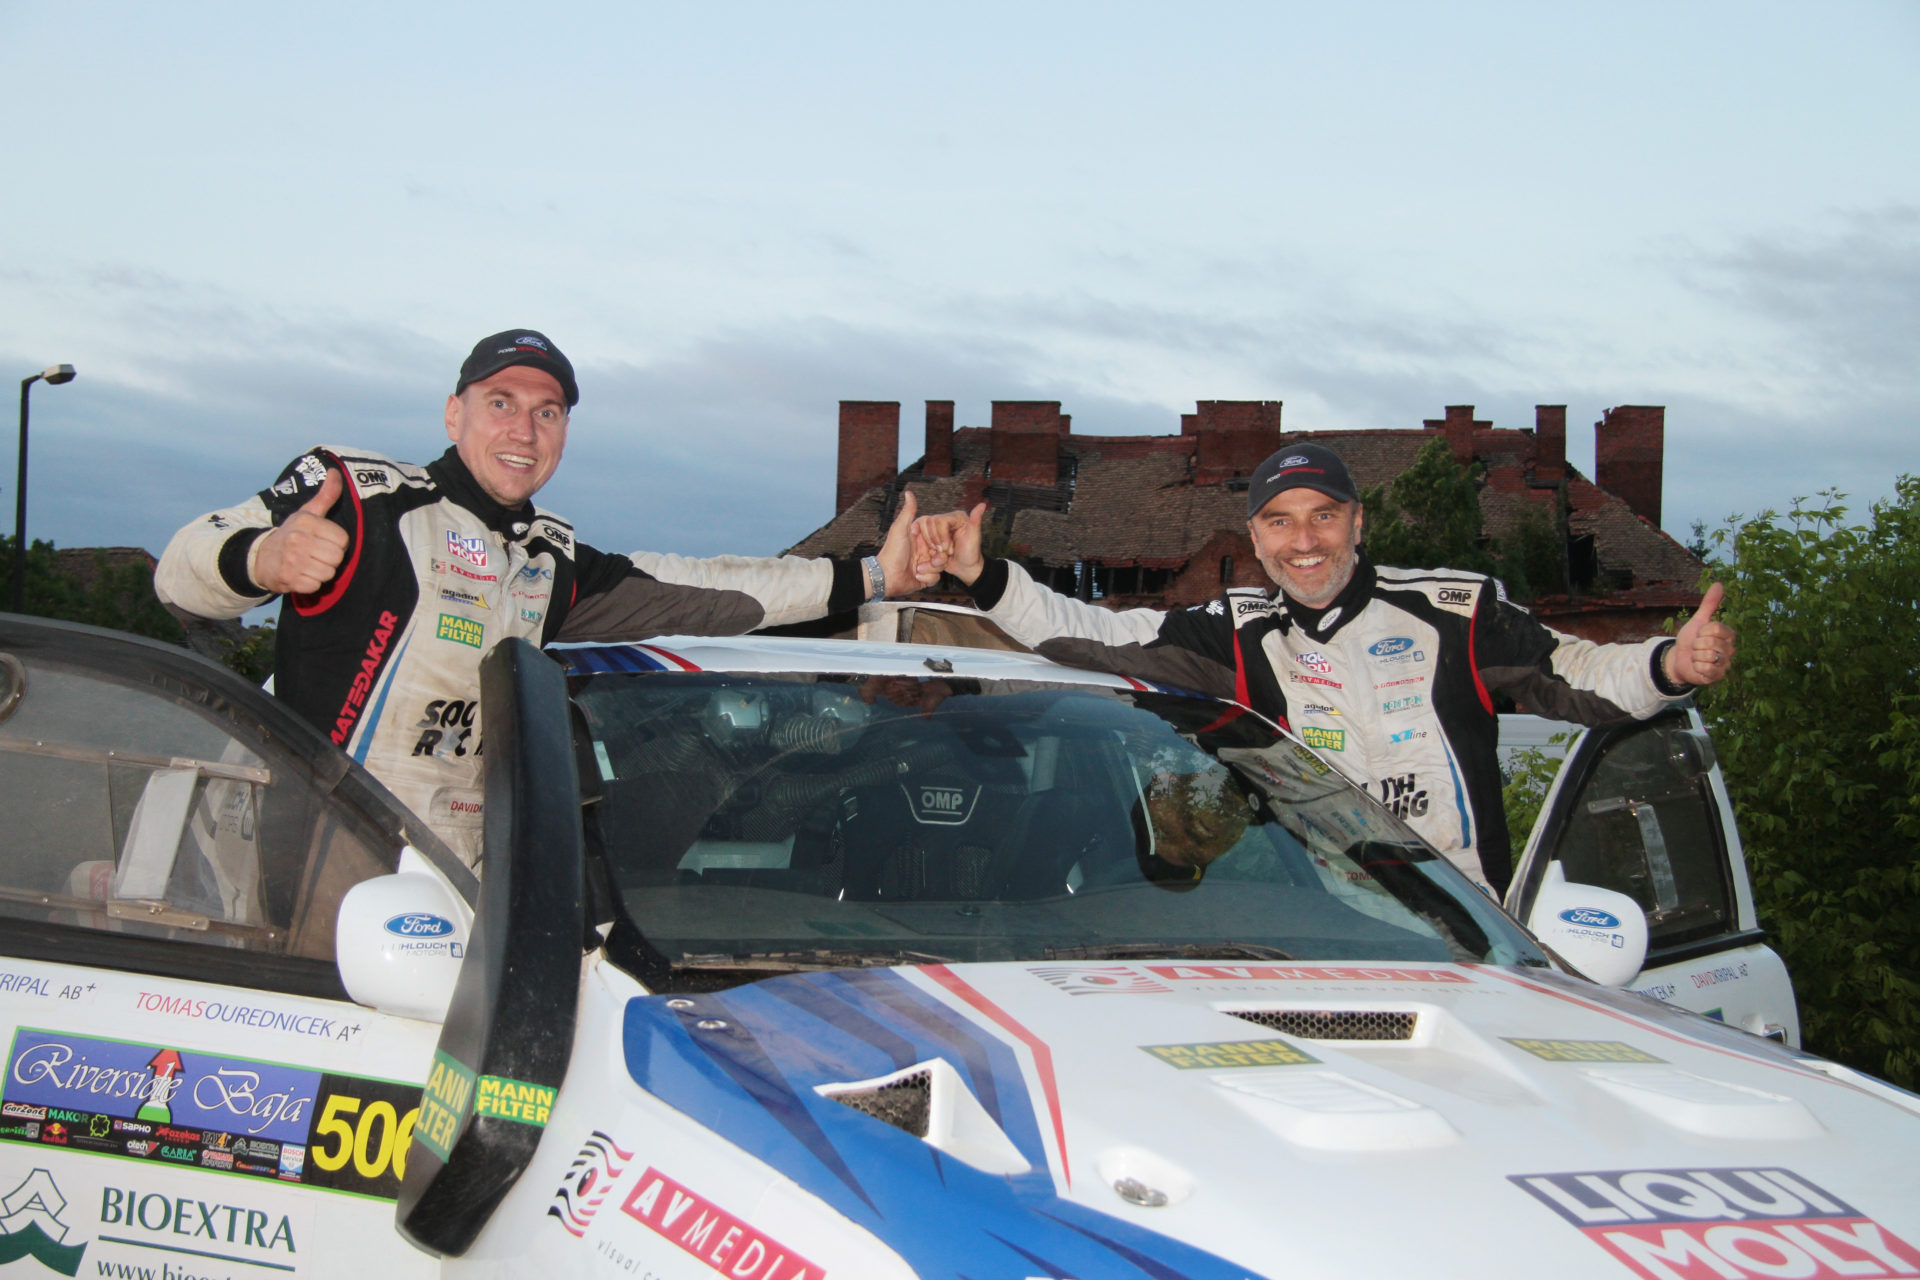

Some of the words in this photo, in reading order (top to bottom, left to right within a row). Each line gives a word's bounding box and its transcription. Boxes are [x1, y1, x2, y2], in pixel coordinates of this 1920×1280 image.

[356, 470, 390, 485] OMP
[544, 526, 571, 546] OMP
[449, 544, 485, 566] MOLY
[442, 588, 480, 602] agados
[1437, 589, 1472, 603] OMP
[441, 615, 482, 634] MANN
[439, 627, 481, 647] FILTER
[1375, 640, 1406, 655] Ford
[1303, 728, 1342, 741] MANN
[1304, 738, 1342, 750] FILTER
[450, 801, 483, 813] DAVID
[922, 791, 963, 809] OMP
[401, 914, 442, 933] Ford
[1570, 910, 1609, 925] Ford
[1568, 928, 1610, 939] HLOUCH
[400, 942, 448, 950] HLOUCH
[1152, 1041, 1278, 1057] MANN
[1172, 1052, 1309, 1067] FILTER
[14, 1043, 184, 1104] Riverside
[193, 1066, 312, 1133] Baja
[427, 1055, 471, 1114] ANN
[480, 1078, 554, 1107] MANN
[47, 1109, 90, 1123] MAKOR
[477, 1096, 550, 1124] FILTER
[312, 1094, 421, 1182] 506
[1522, 1169, 1847, 1223] LIQUI
[101, 1186, 296, 1253] BIOEXTRA
[631, 1177, 806, 1280] AVMEDI
[597, 1239, 641, 1275] visual
[1601, 1221, 1920, 1280] MOLY
